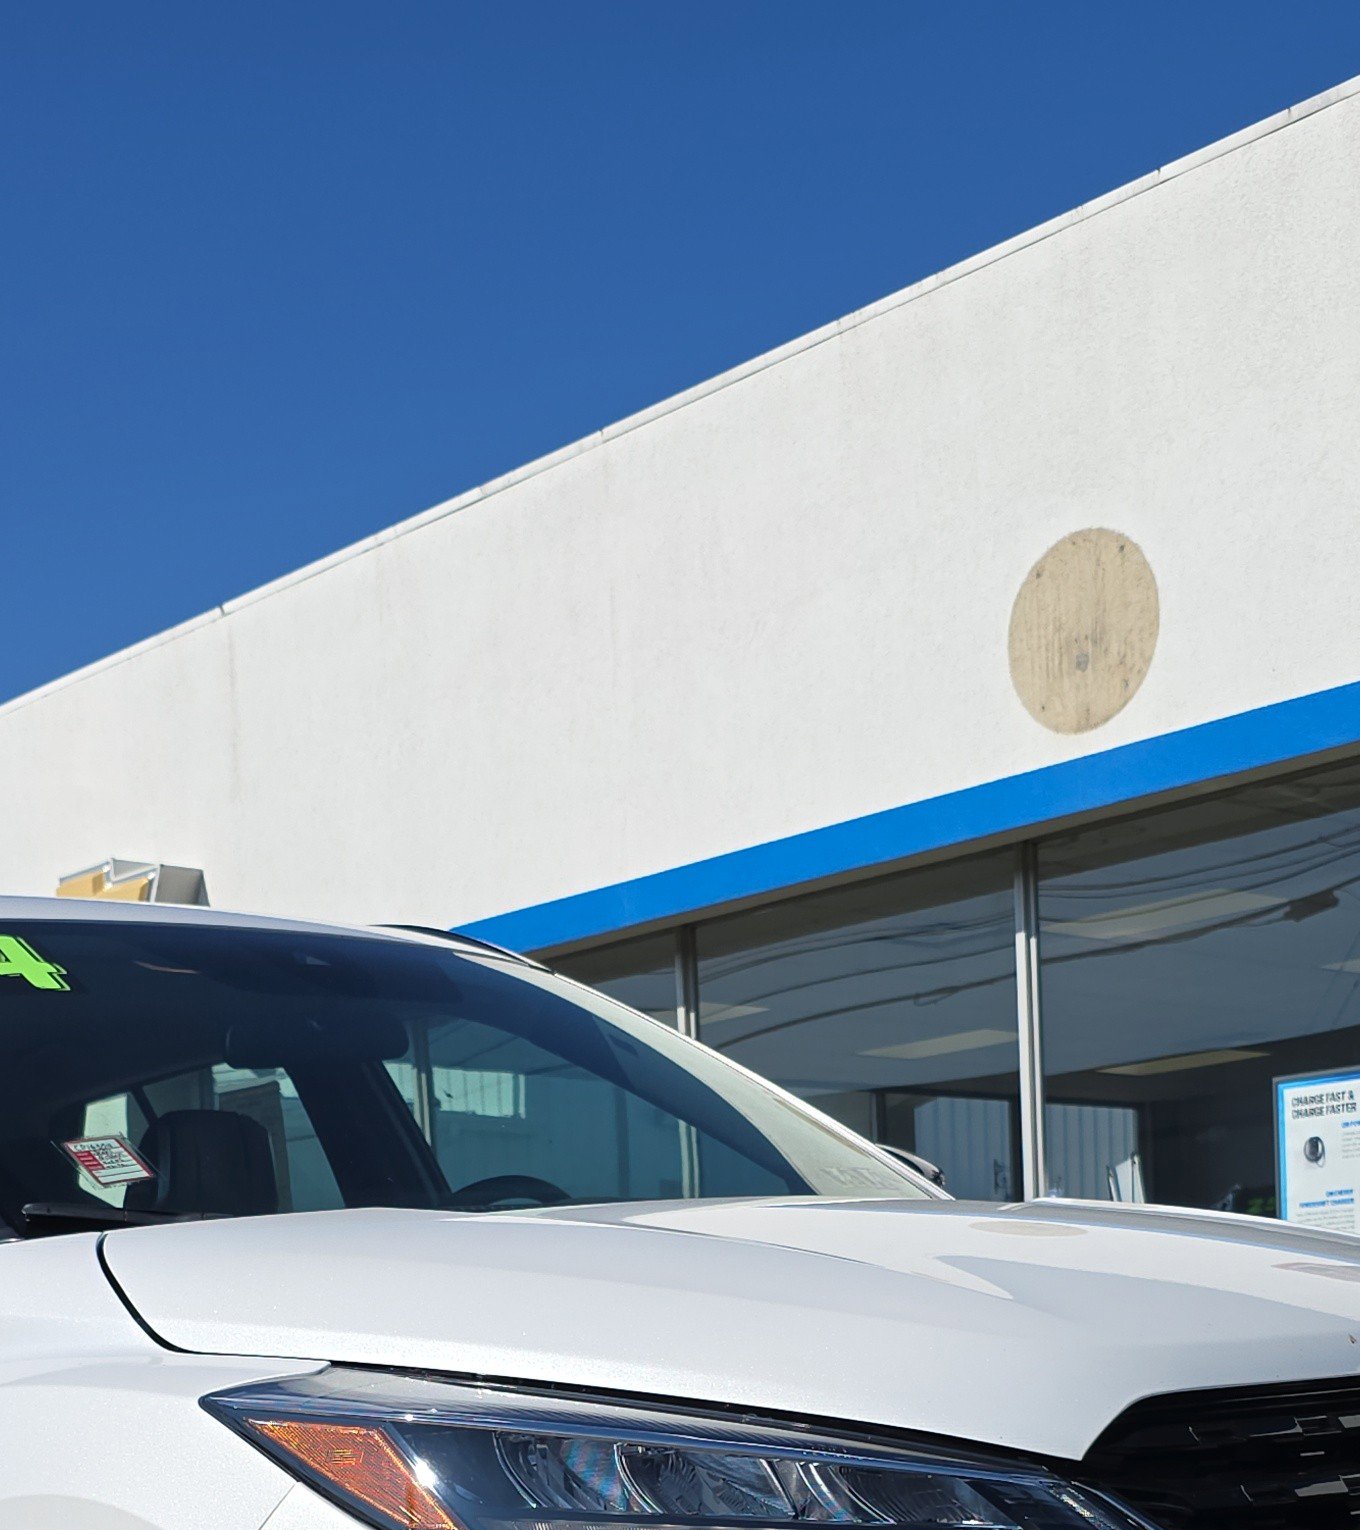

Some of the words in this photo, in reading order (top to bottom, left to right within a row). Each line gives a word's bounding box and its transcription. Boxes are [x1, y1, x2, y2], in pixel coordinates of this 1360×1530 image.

[1291, 1093, 1325, 1107] CHARGE
[1325, 1090, 1346, 1103] FAST
[1291, 1106, 1325, 1119] CHARGE
[1325, 1102, 1357, 1115] FASTER
